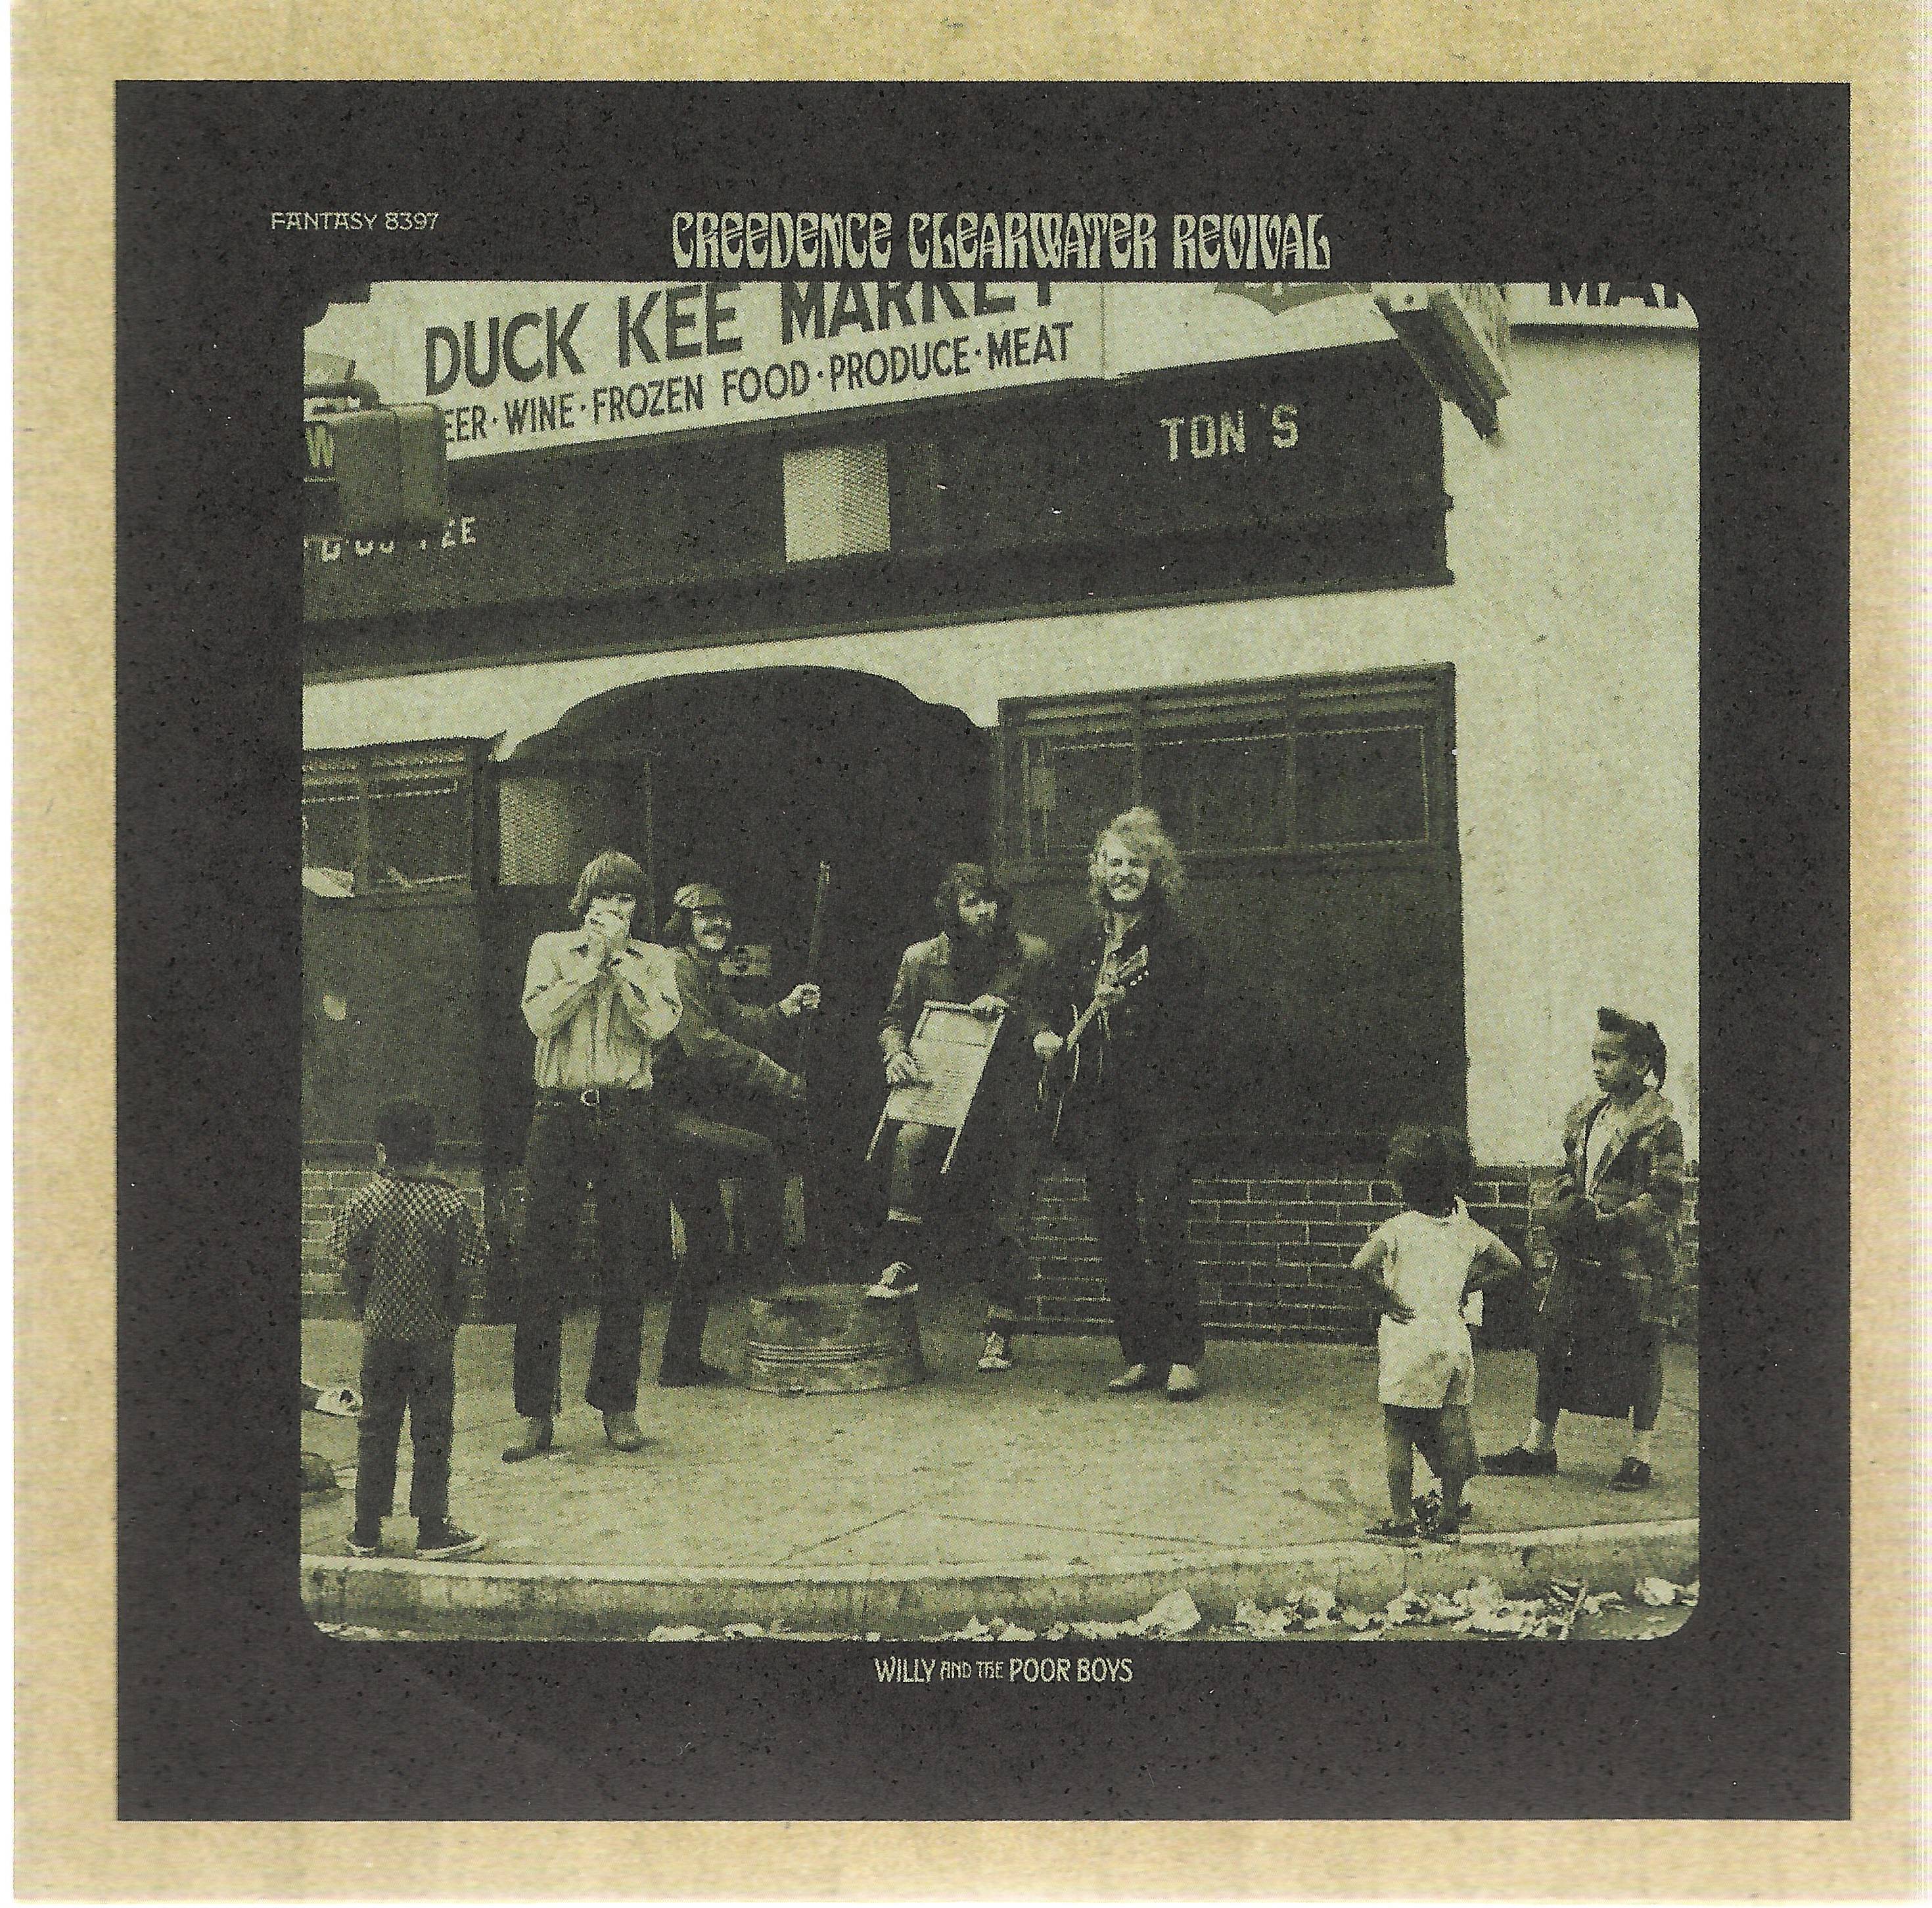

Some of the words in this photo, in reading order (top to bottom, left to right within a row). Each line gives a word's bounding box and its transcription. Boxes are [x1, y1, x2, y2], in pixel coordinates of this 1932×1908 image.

[271, 212, 378, 231] FANTASY
[384, 212, 439, 231] 8397
[672, 212, 892, 269] CREEDENCE
[908, 212, 1157, 269] CLEARWATER
[1172, 213, 1331, 269] REVIVAL
[426, 302, 589, 395] DUCK
[618, 282, 743, 367] KEE
[445, 405, 487, 442] EER
[505, 392, 575, 436] WINE
[592, 375, 704, 424] FROZEN
[723, 361, 810, 405] FOOD
[829, 336, 971, 392] PRODUCE
[986, 321, 1074, 370] MEAT
[875, 1656, 936, 1683] WILLY
[939, 1660, 972, 1681] AND
[975, 1660, 1004, 1679] THE
[1009, 1657, 1071, 1682] POOR
[1077, 1657, 1133, 1683] BOYS
